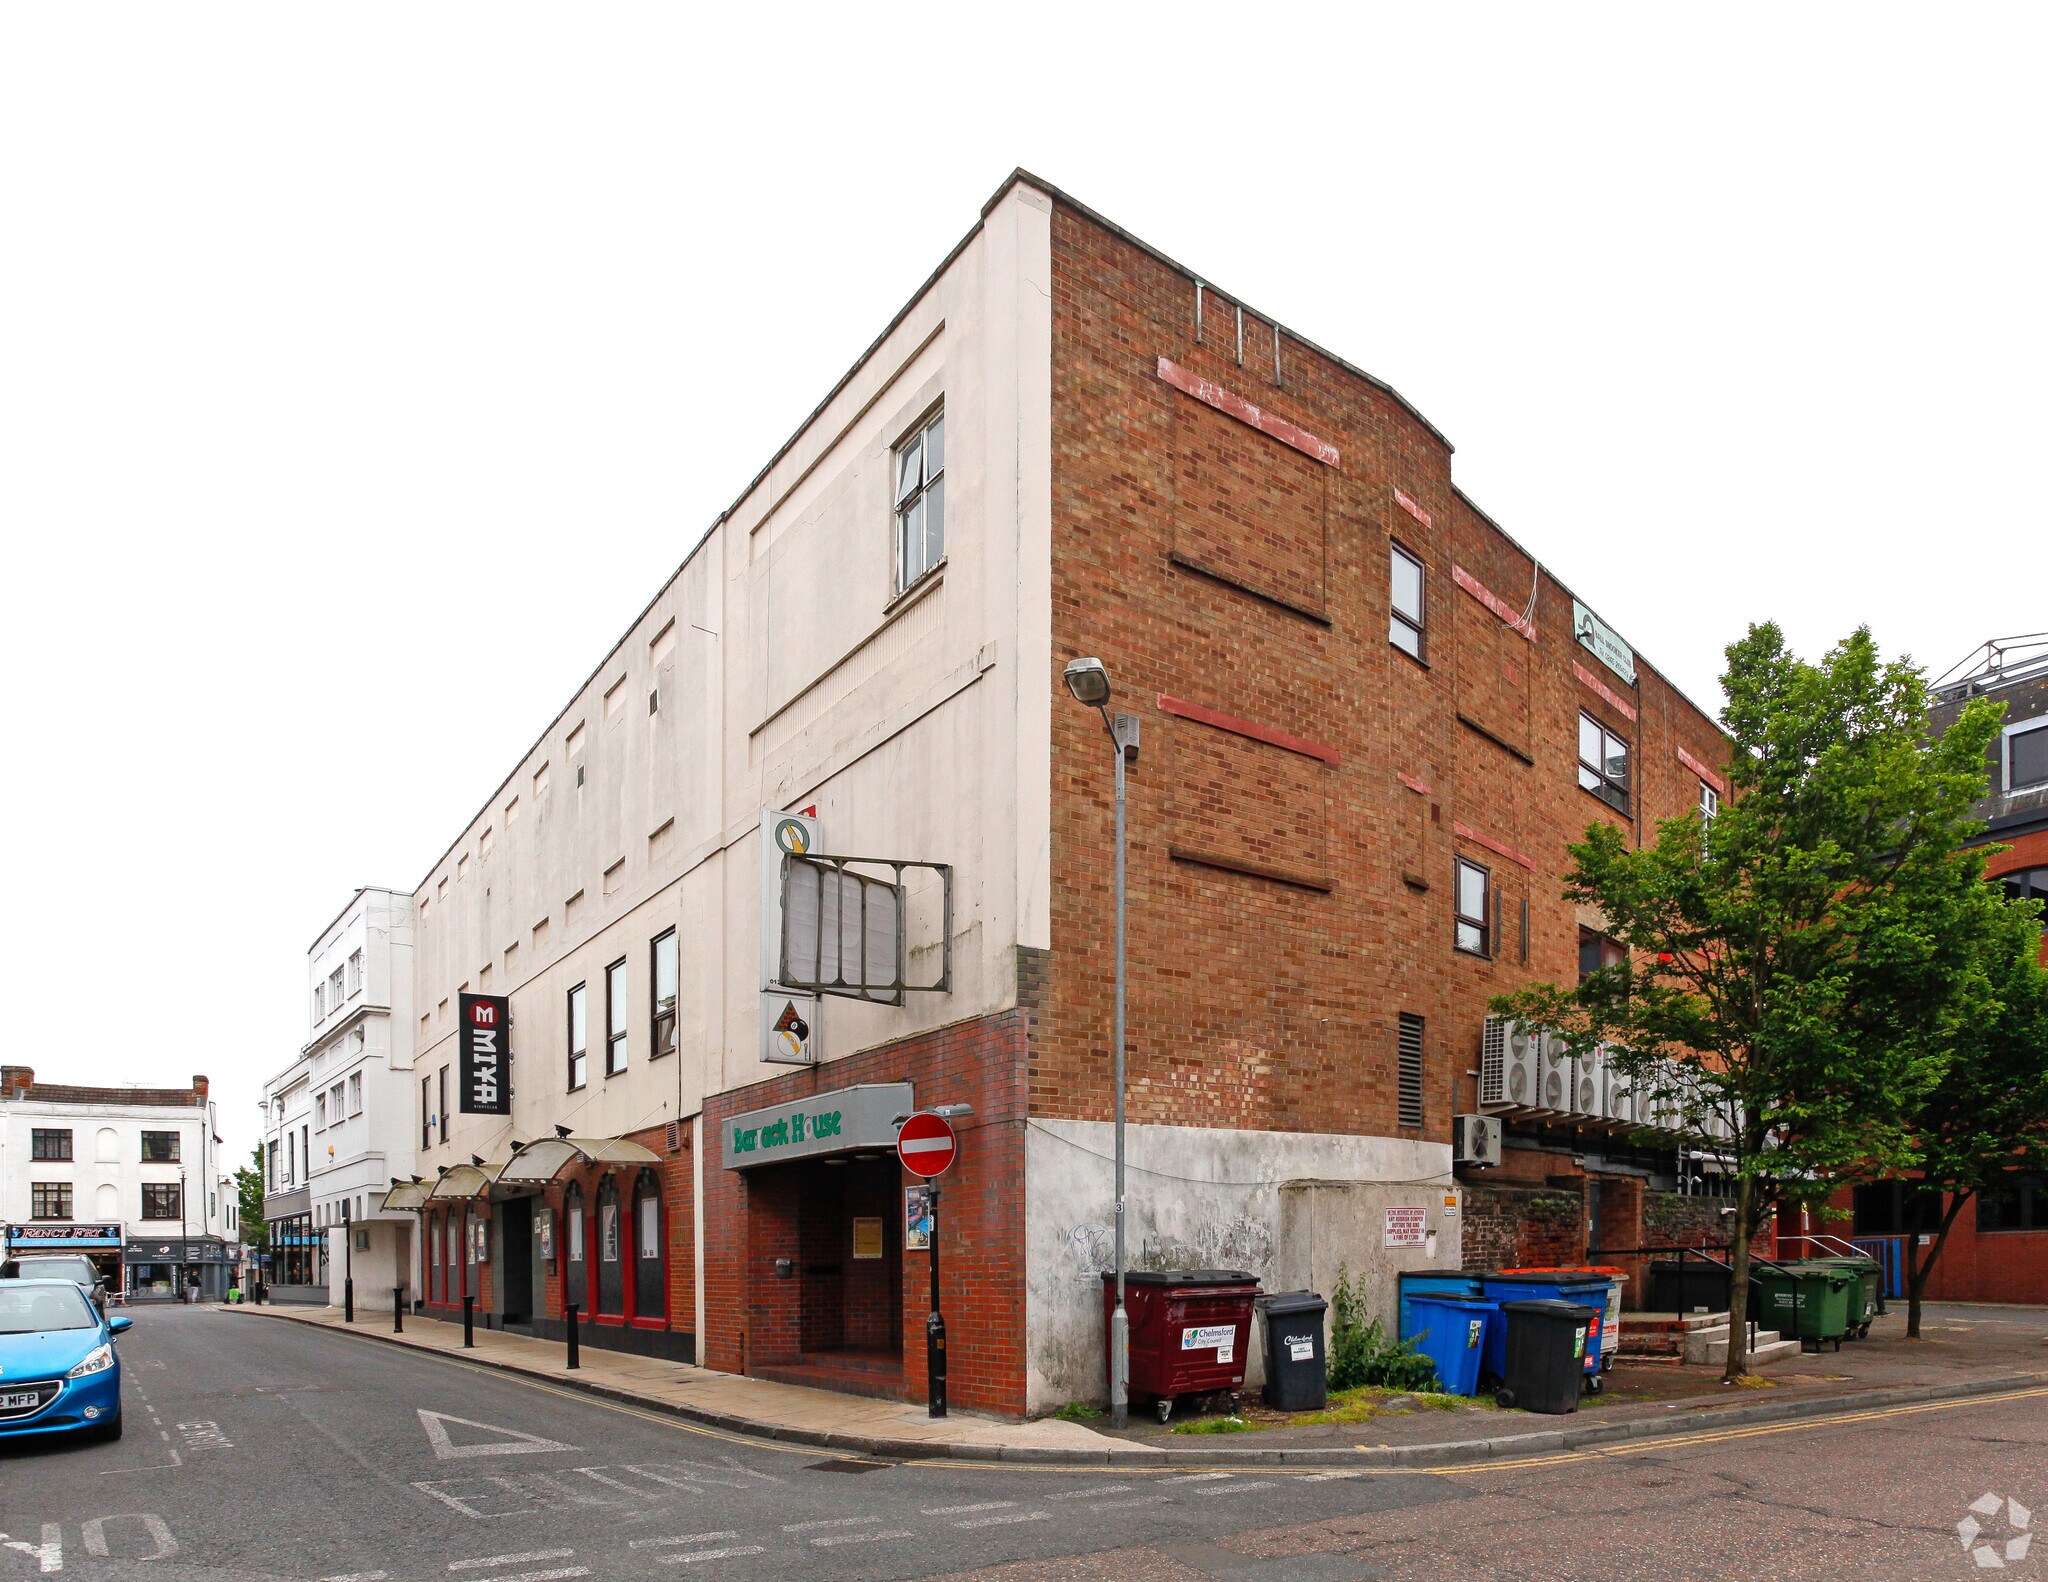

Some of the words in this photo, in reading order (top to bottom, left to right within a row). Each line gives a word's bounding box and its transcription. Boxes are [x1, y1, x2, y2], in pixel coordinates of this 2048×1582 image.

[475, 1005, 494, 1023] M
[473, 1028, 498, 1104] MIKA
[1116, 1203, 1122, 1212] 3
[20, 1227, 71, 1239] FANCY
[70, 1227, 104, 1239] FRY
[1199, 1326, 1234, 1338] Chelmsford
[8, 1393, 36, 1406] MFP
